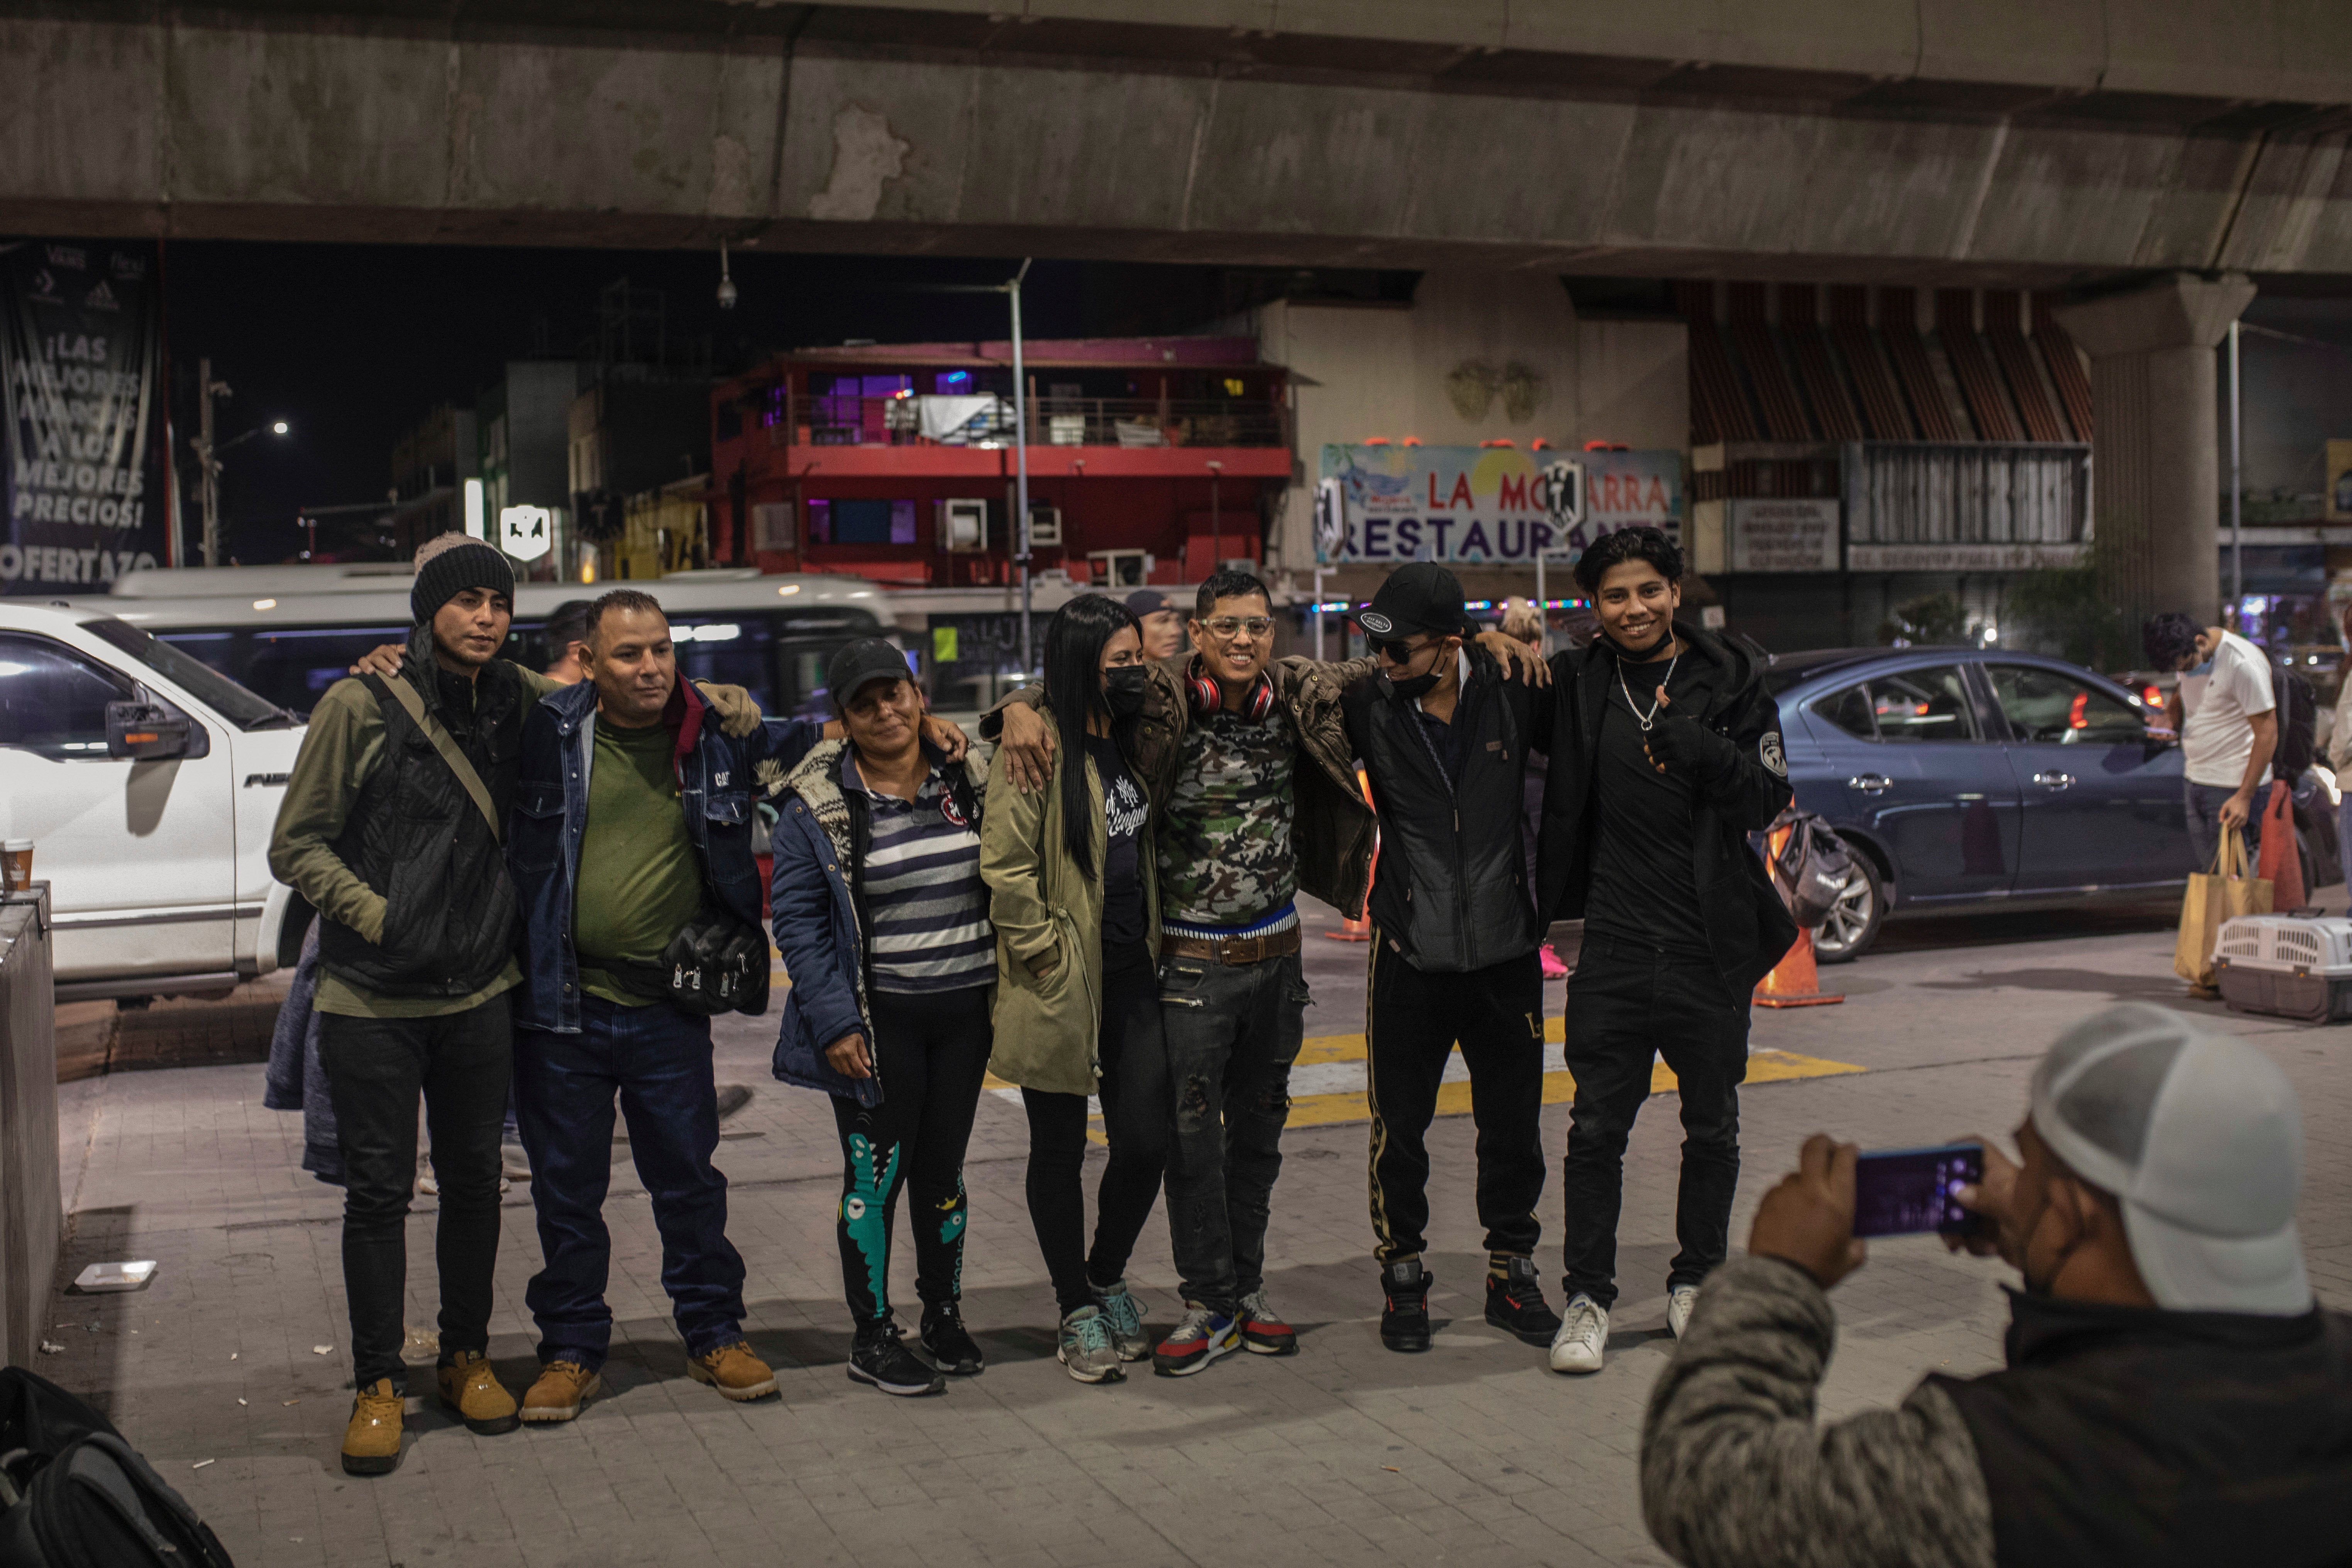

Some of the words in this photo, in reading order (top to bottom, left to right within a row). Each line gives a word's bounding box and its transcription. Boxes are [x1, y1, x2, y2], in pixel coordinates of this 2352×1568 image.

[15, 458, 144, 497] MEJORES
[1429, 471, 1474, 510] LA
[1499, 473, 1668, 513] MOARRA
[14, 492, 144, 529] PRECIOS!
[1345, 518, 1679, 556] ESTAURA
[1375, 619, 1388, 628] DELTA
[715, 771, 730, 787] CAT
